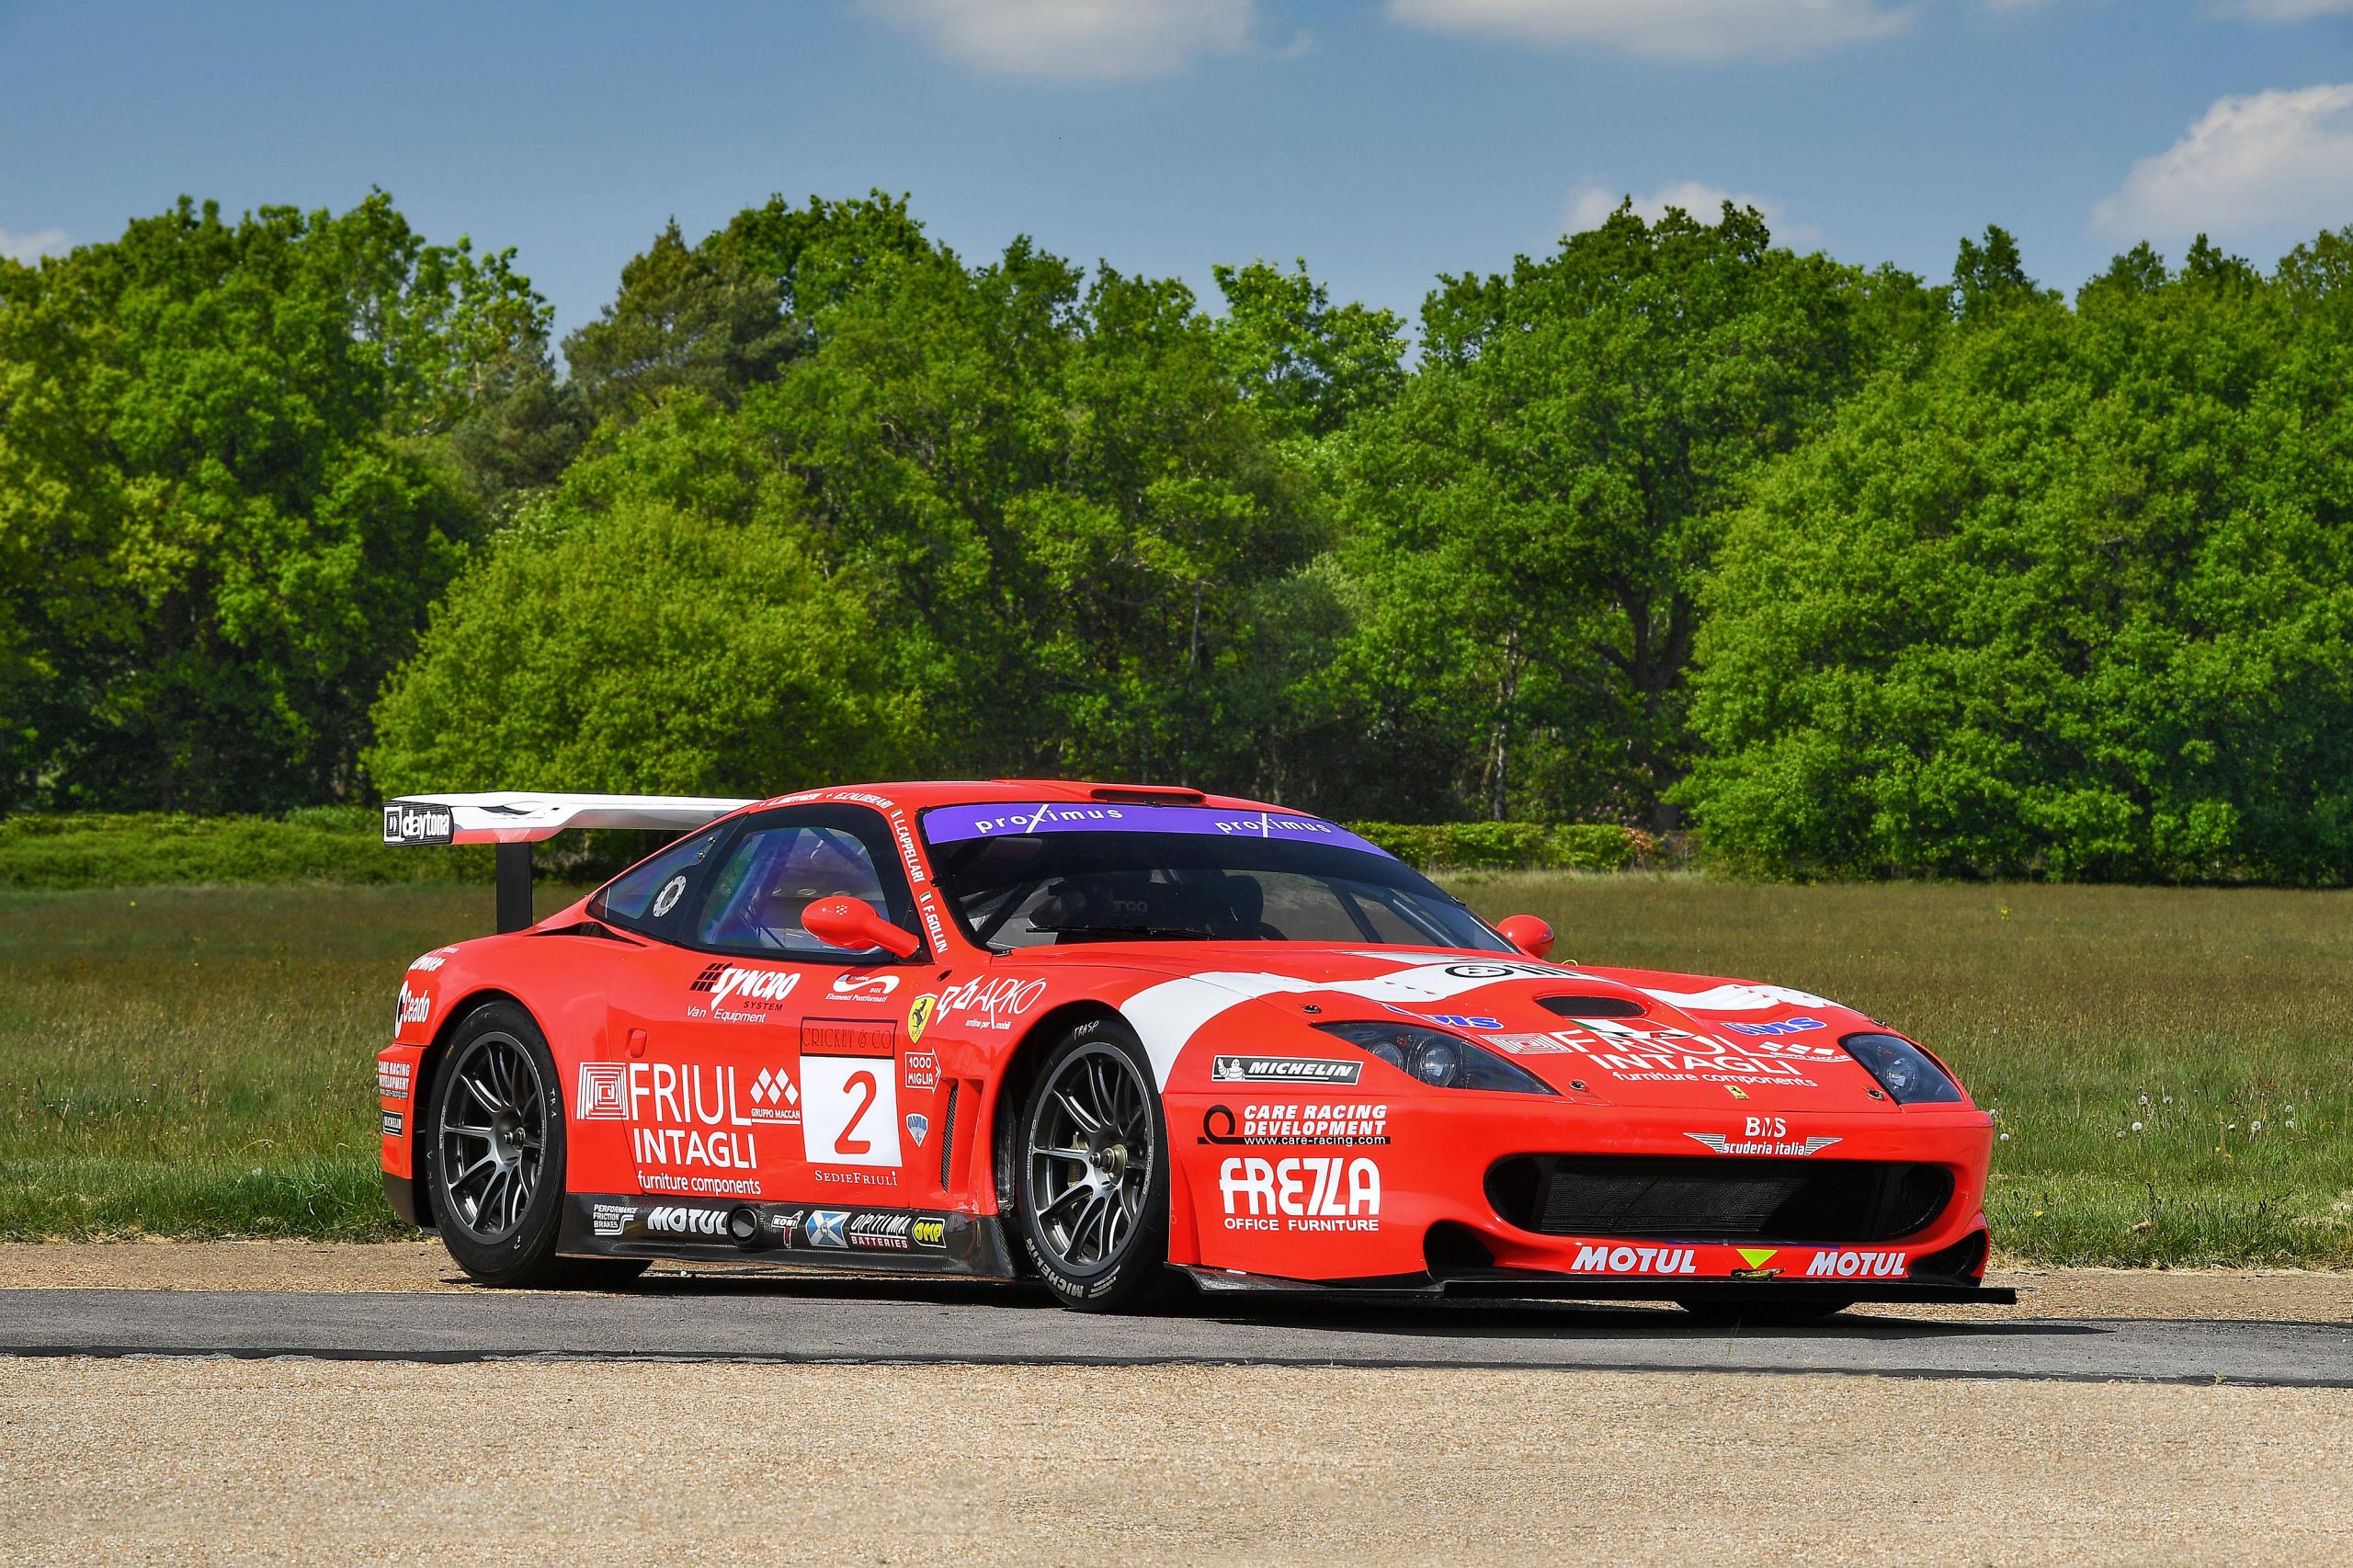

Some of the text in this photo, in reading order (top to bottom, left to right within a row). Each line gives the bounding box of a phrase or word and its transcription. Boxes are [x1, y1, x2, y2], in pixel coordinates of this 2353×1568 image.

[403, 810, 450, 839] daytona
[974, 803, 1124, 834] proximus
[1214, 812, 1332, 837] proximus
[893, 819, 926, 883] L.CAPPELLARI
[923, 904, 949, 954] F.GOLLIN
[710, 968, 801, 1012] SYNCRO
[404, 989, 431, 1023] Ceado
[687, 1006, 767, 1023] Van Equipment
[744, 1001, 784, 1012] SYSTEM
[802, 1028, 892, 1050] CRICKET & CO
[1554, 1028, 1774, 1057] FRIUL
[390, 1062, 411, 1077] RACING
[909, 1056, 932, 1069] 1000
[1248, 1062, 1354, 1077] MICHELIN
[1587, 1053, 1802, 1076] INTAGLI
[907, 1073, 933, 1085] MIGLIA
[1613, 1072, 1819, 1088] furniture components
[629, 1062, 752, 1127] FRIUL
[751, 1108, 801, 1119] GRUPPO MACCAN
[835, 1071, 877, 1155] 2
[1244, 1105, 1388, 1120] CARE RACING
[1243, 1120, 1387, 1136] DEVELOPMENT
[1745, 1117, 1788, 1138] BMS
[633, 1128, 758, 1169] INTAGLI
[1244, 1136, 1387, 1147] www.care-racing.com
[1723, 1141, 1806, 1156] scuderia italia
[637, 1170, 762, 1196] furniture components
[1219, 1157, 1381, 1216] FREZZA
[593, 1204, 639, 1214] PERFORMANCE
[593, 1212, 620, 1221] FRICTION
[593, 1220, 619, 1229] BRAKES
[647, 1206, 729, 1235] MOTUL
[773, 1217, 797, 1227] KONI
[850, 1212, 912, 1234] OPTIMA
[1224, 1218, 1380, 1232] OFFICE FURNITURE
[851, 1235, 908, 1248] BATTERIES
[914, 1221, 943, 1243] OMP
[1025, 1238, 1085, 1298] MICHELIN
[1570, 1245, 1697, 1274] MOTUL
[1805, 1251, 1907, 1277] MOTUL
